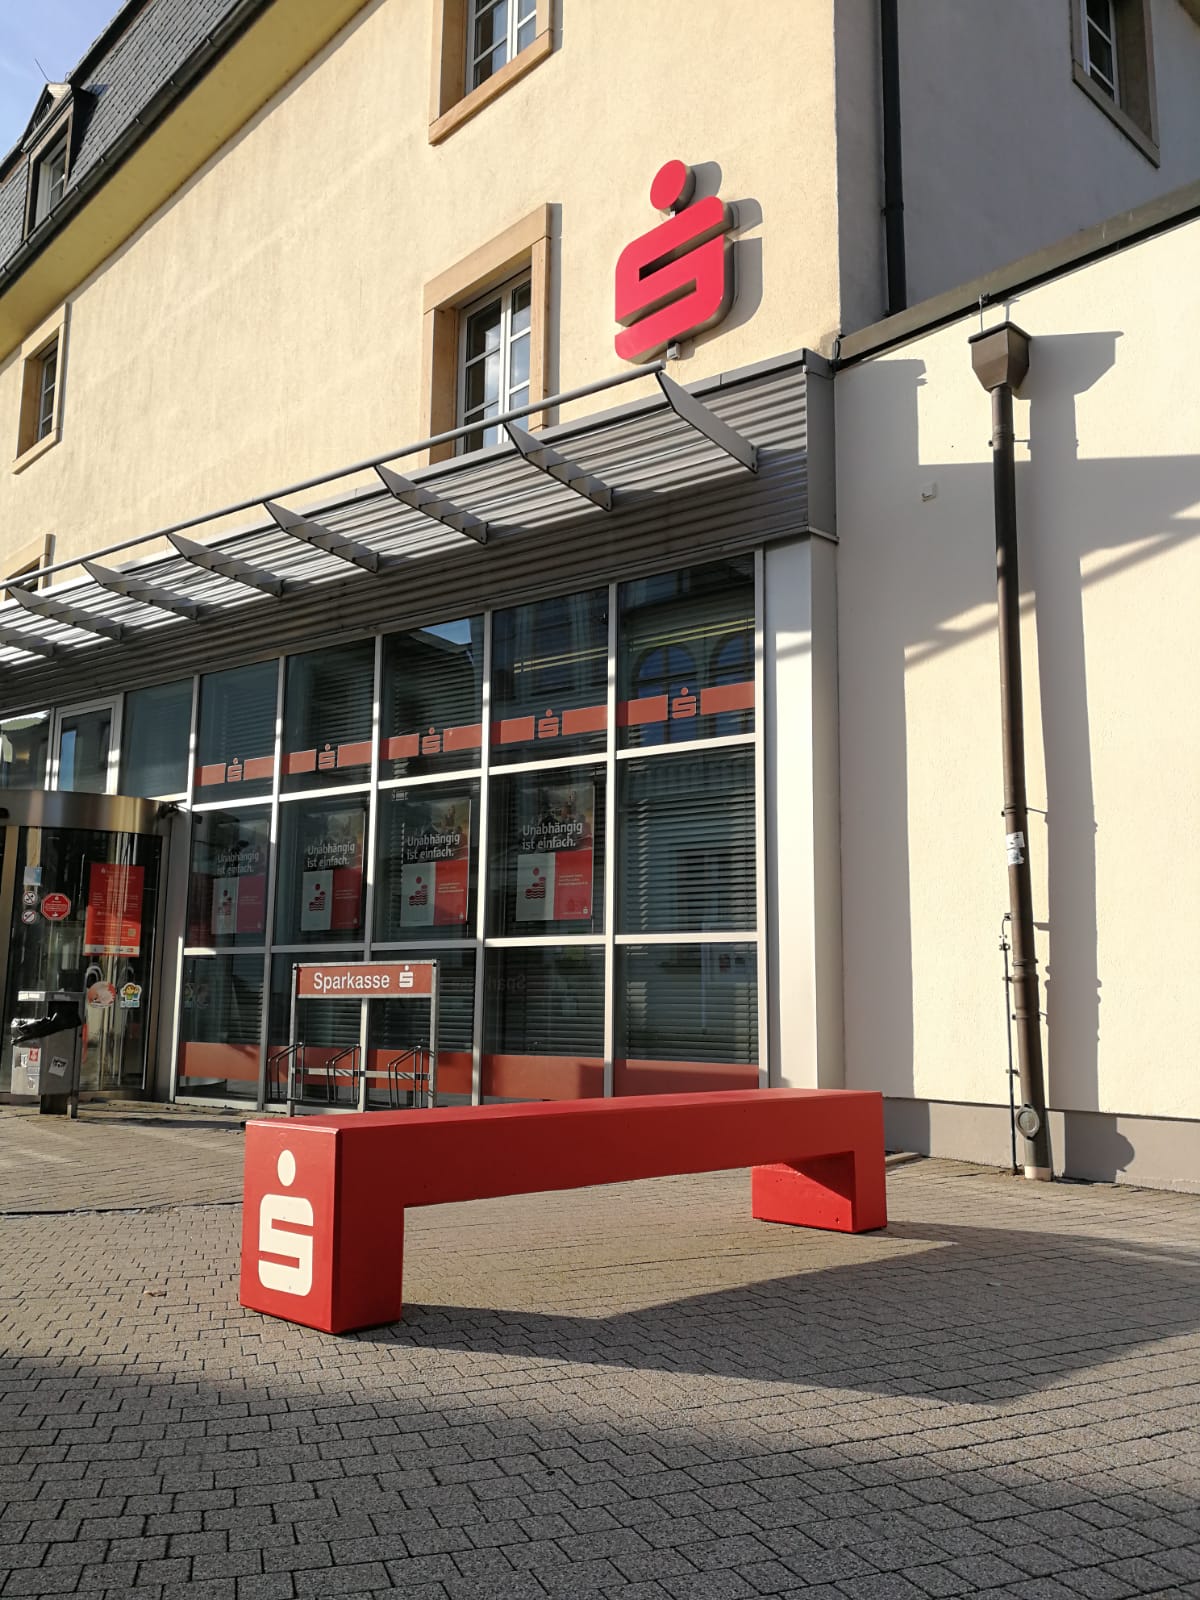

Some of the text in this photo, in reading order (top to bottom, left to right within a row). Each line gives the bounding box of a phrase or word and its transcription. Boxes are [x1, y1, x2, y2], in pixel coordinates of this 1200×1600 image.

[522, 820, 583, 836] Unabhängig
[406, 833, 461, 847] Unabhängig
[522, 836, 577, 850] ist einfach.
[406, 846, 454, 860] ist einfach.
[307, 857, 317, 868] ist
[313, 971, 390, 993] Sparkasse
